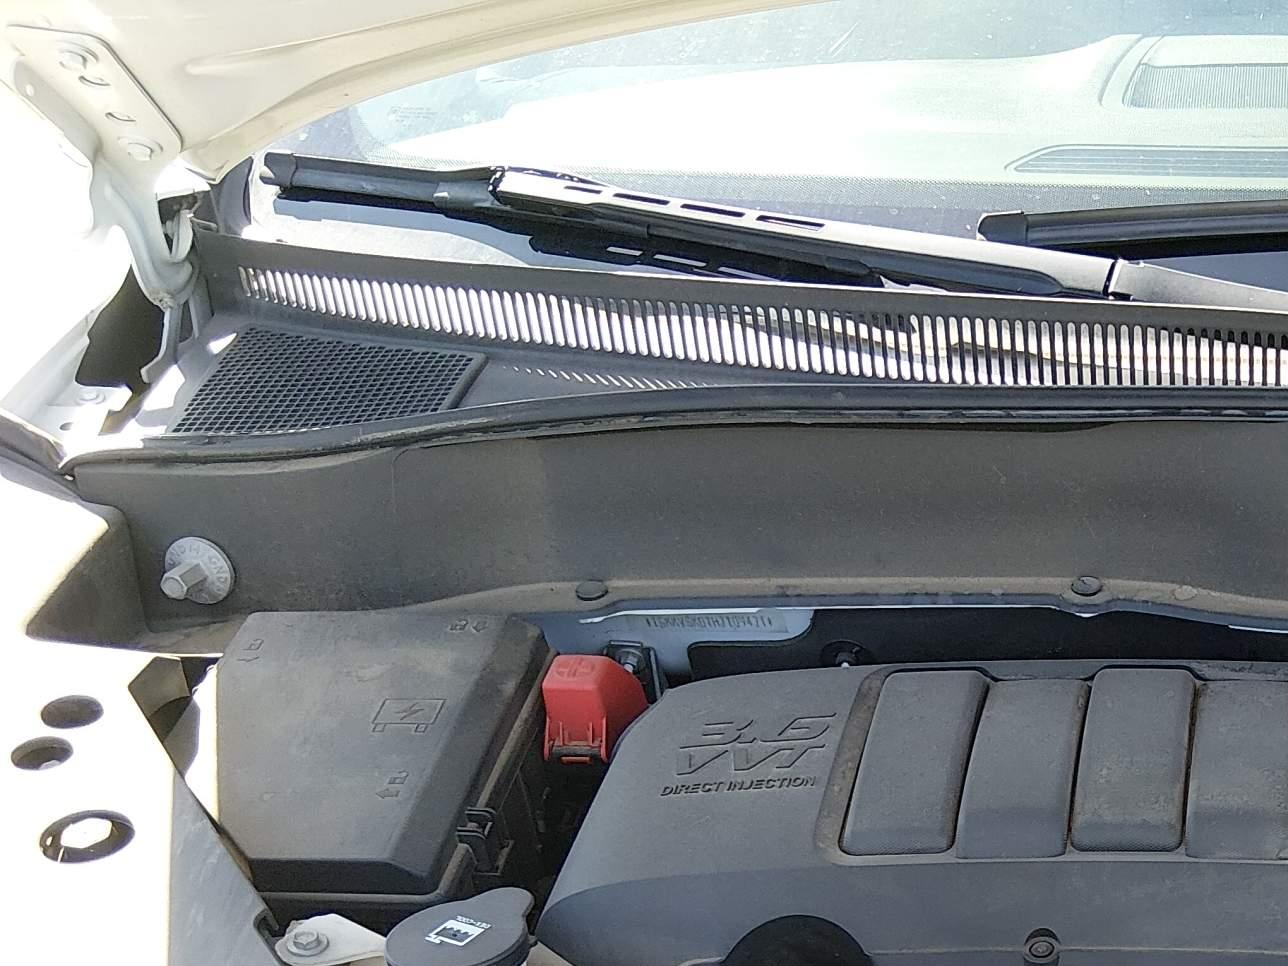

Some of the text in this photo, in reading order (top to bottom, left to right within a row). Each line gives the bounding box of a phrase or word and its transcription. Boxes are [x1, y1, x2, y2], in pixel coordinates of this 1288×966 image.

[679, 712, 837, 750] 3.6
[676, 743, 826, 776] VVT
[660, 775, 817, 797] DIRECT INJECTION
